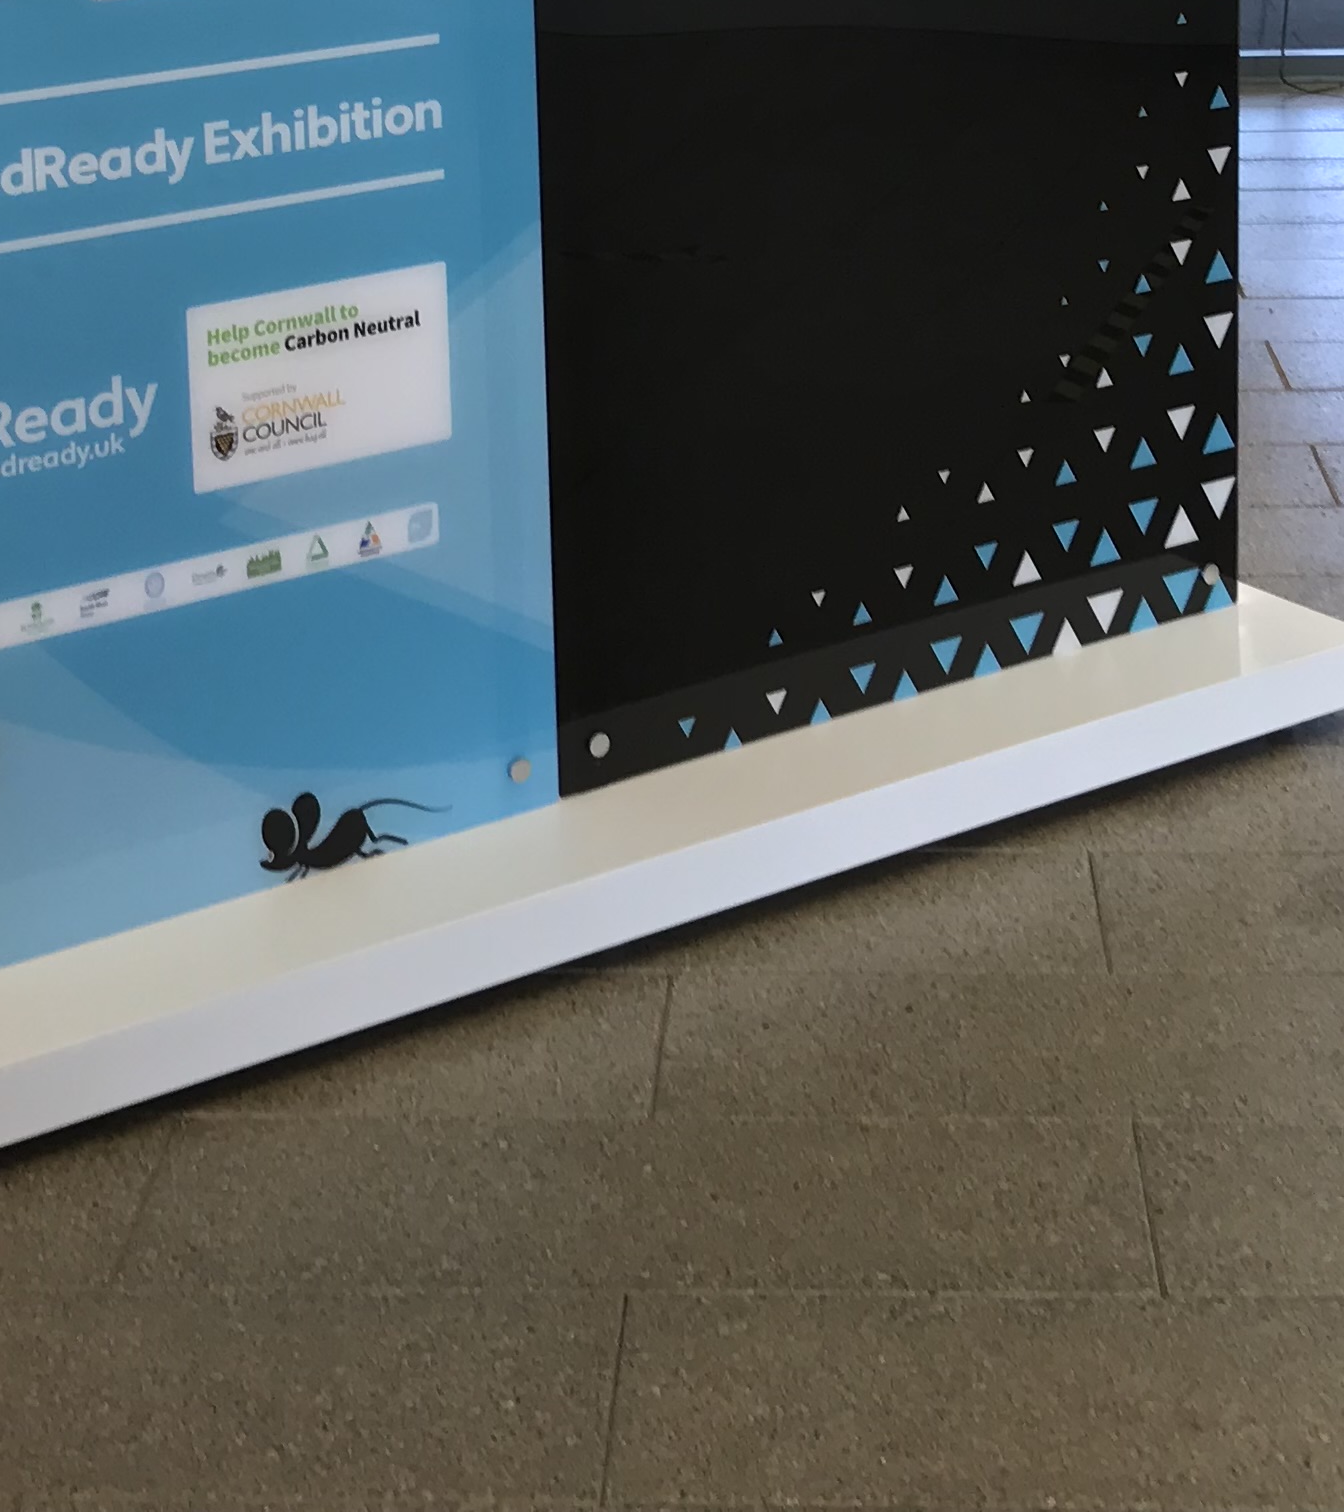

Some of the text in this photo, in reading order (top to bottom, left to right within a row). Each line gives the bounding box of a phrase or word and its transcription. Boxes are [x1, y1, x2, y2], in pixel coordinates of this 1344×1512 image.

[203, 96, 442, 165] Exhibition
[207, 304, 359, 346] Help Cornwall to
[208, 309, 421, 367] become Carbon Neutral
[242, 389, 346, 425] CORNWALL
[243, 411, 327, 443] COUNCIL
